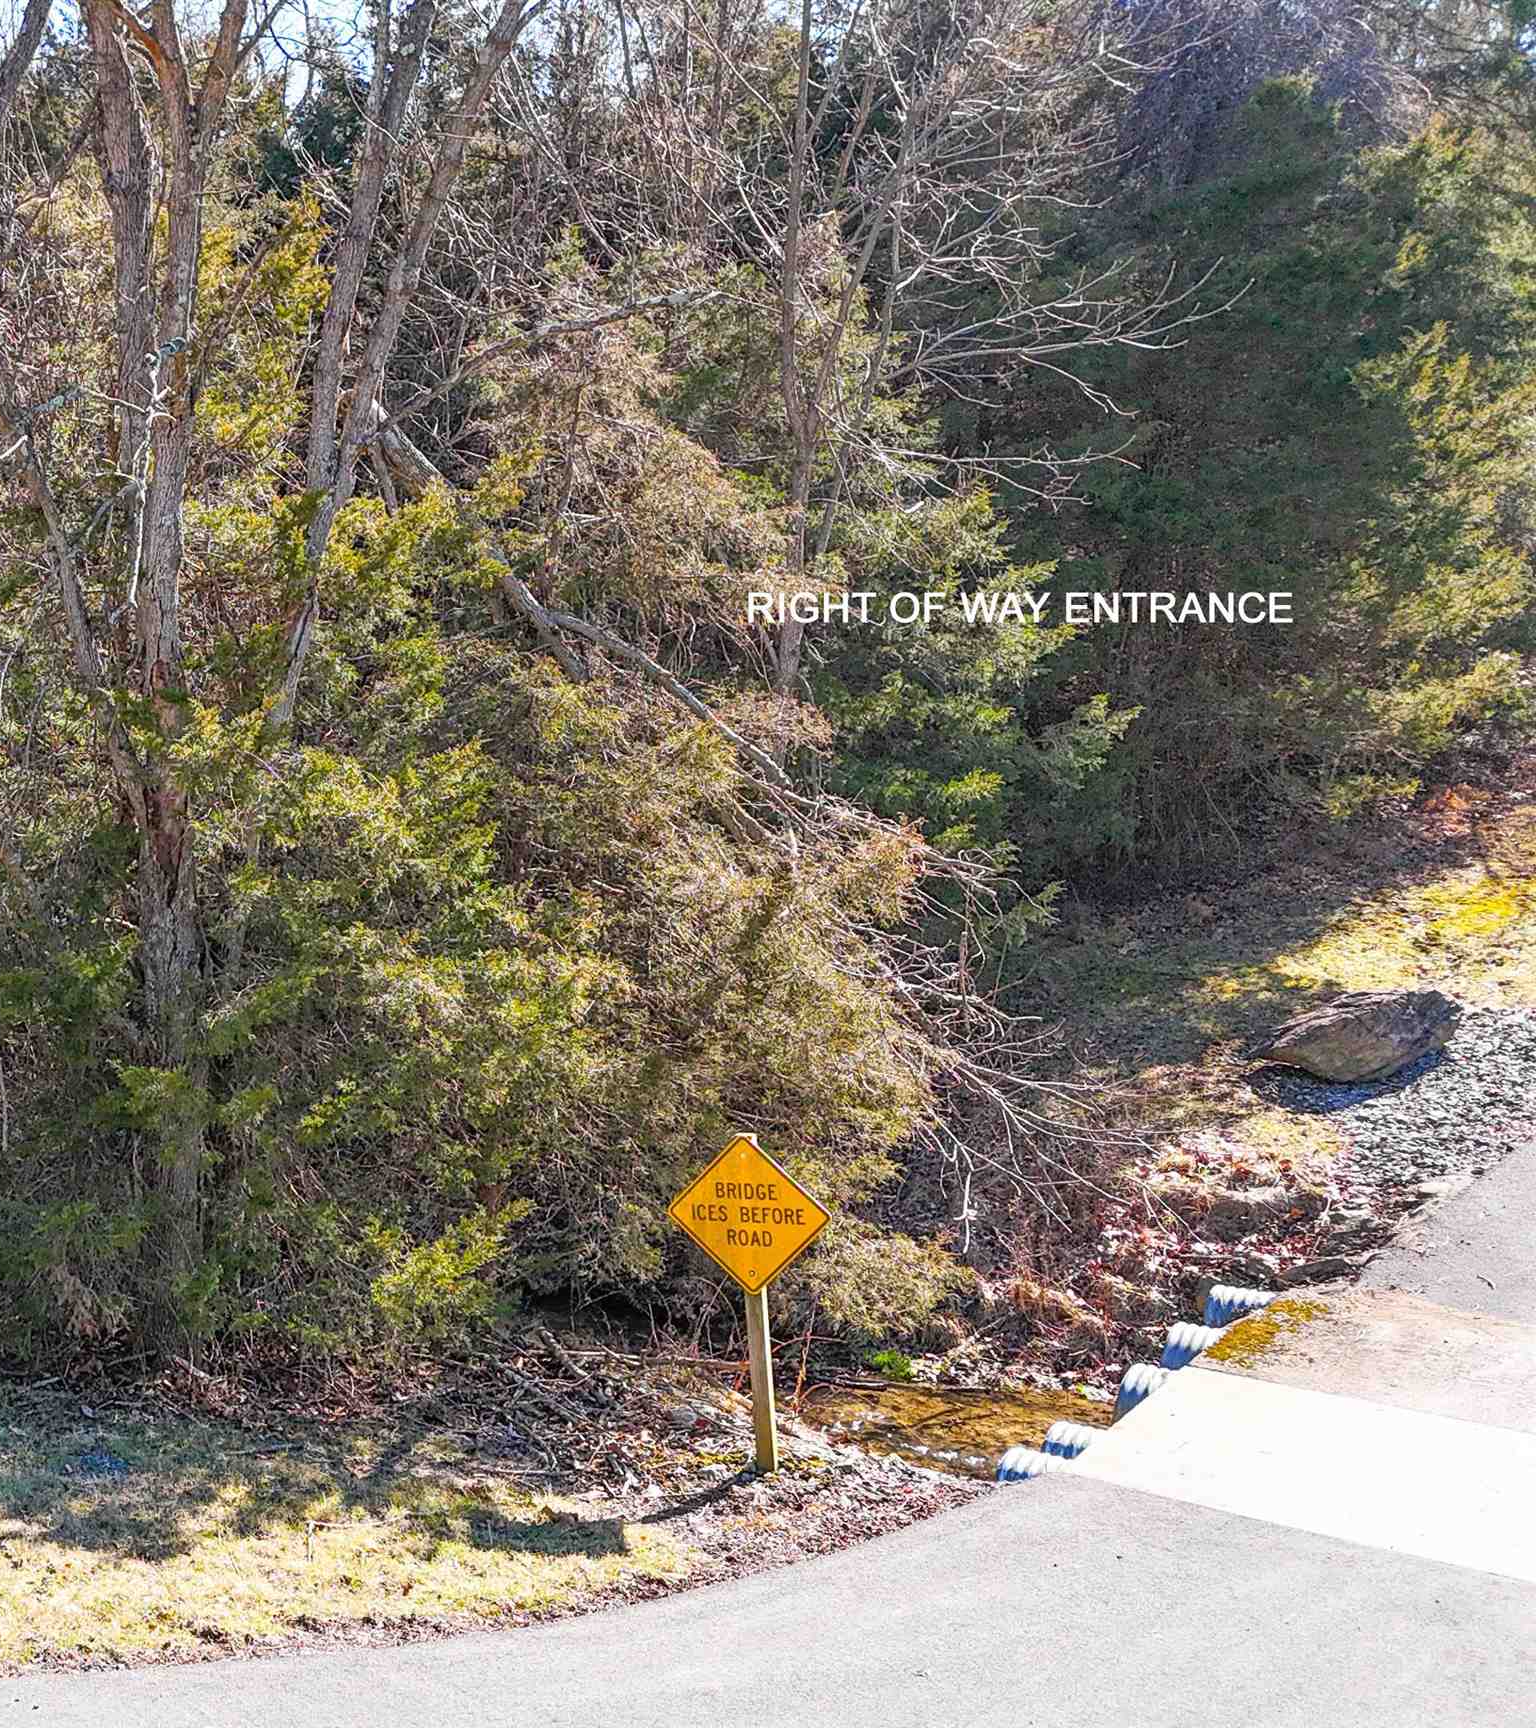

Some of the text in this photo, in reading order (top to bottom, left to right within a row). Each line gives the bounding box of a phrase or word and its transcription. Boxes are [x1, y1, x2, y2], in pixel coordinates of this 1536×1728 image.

[715, 1182, 777, 1200] BRIDGE
[691, 1204, 806, 1225] ICES BEFORE
[727, 1229, 773, 1247] ROAD
